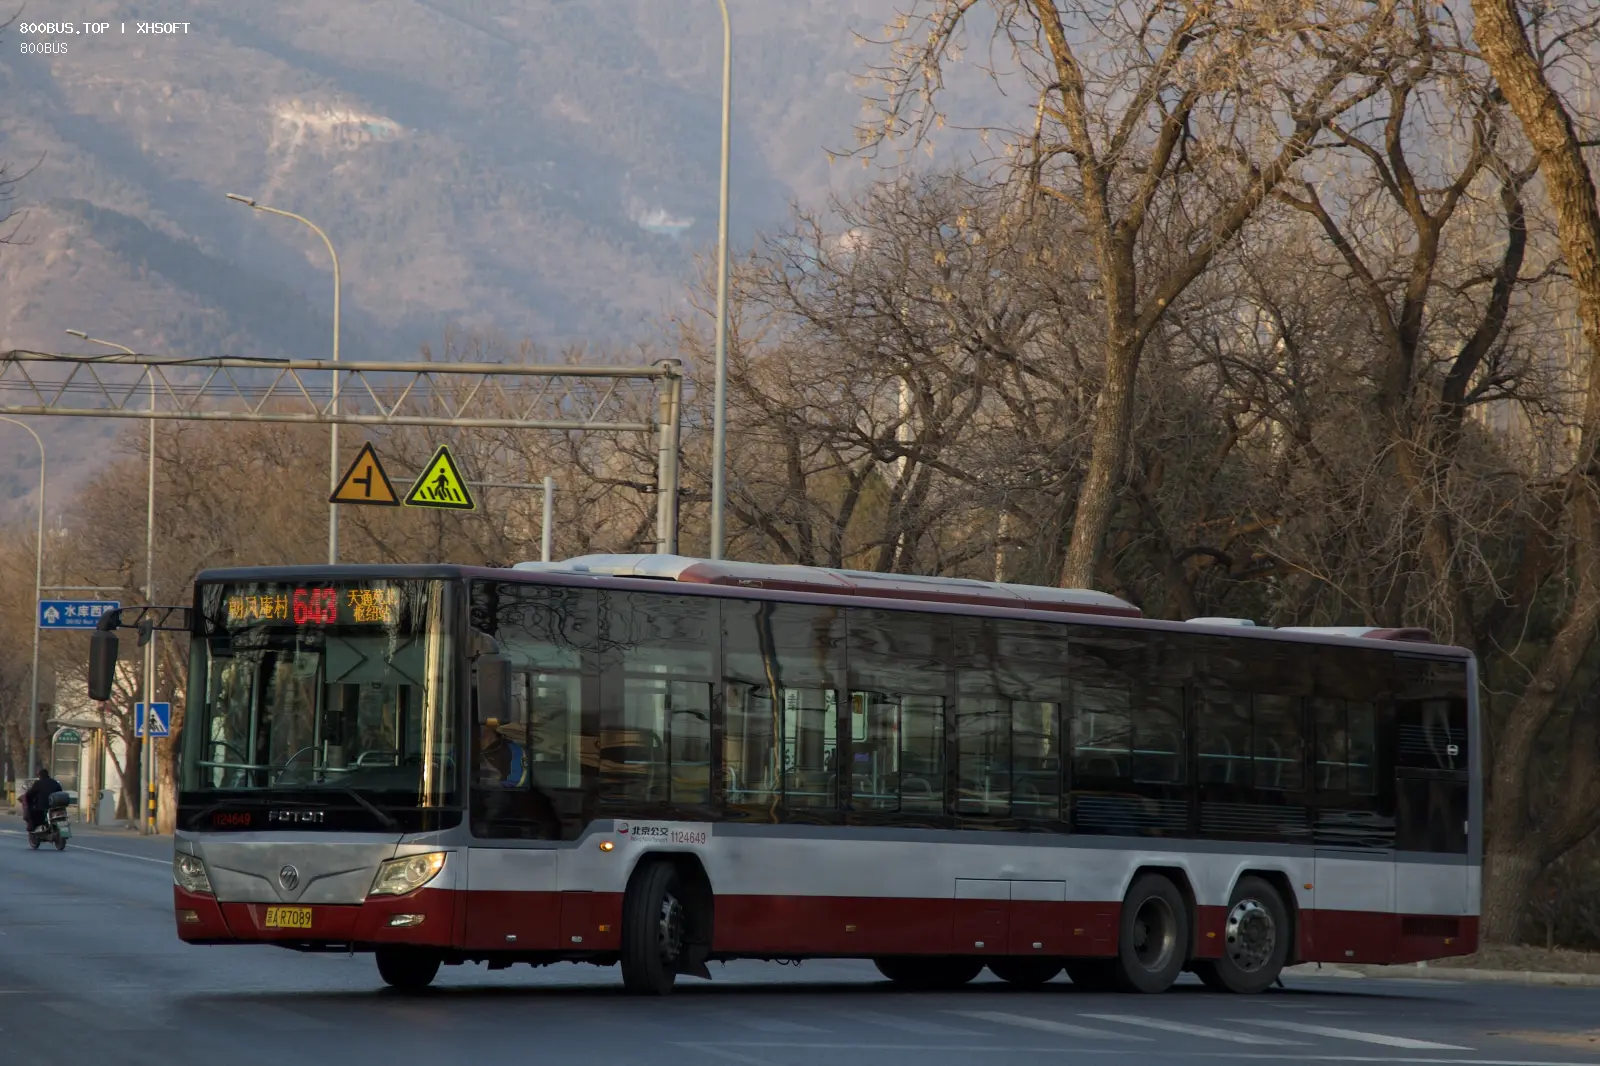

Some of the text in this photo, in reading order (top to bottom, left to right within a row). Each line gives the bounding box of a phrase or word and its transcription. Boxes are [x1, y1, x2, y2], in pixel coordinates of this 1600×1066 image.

[292, 588, 337, 624] 643
[212, 813, 251, 826] 1124649
[268, 810, 324, 823] FOTON
[631, 826, 669, 836] 北京公交
[670, 831, 706, 844] 1124649
